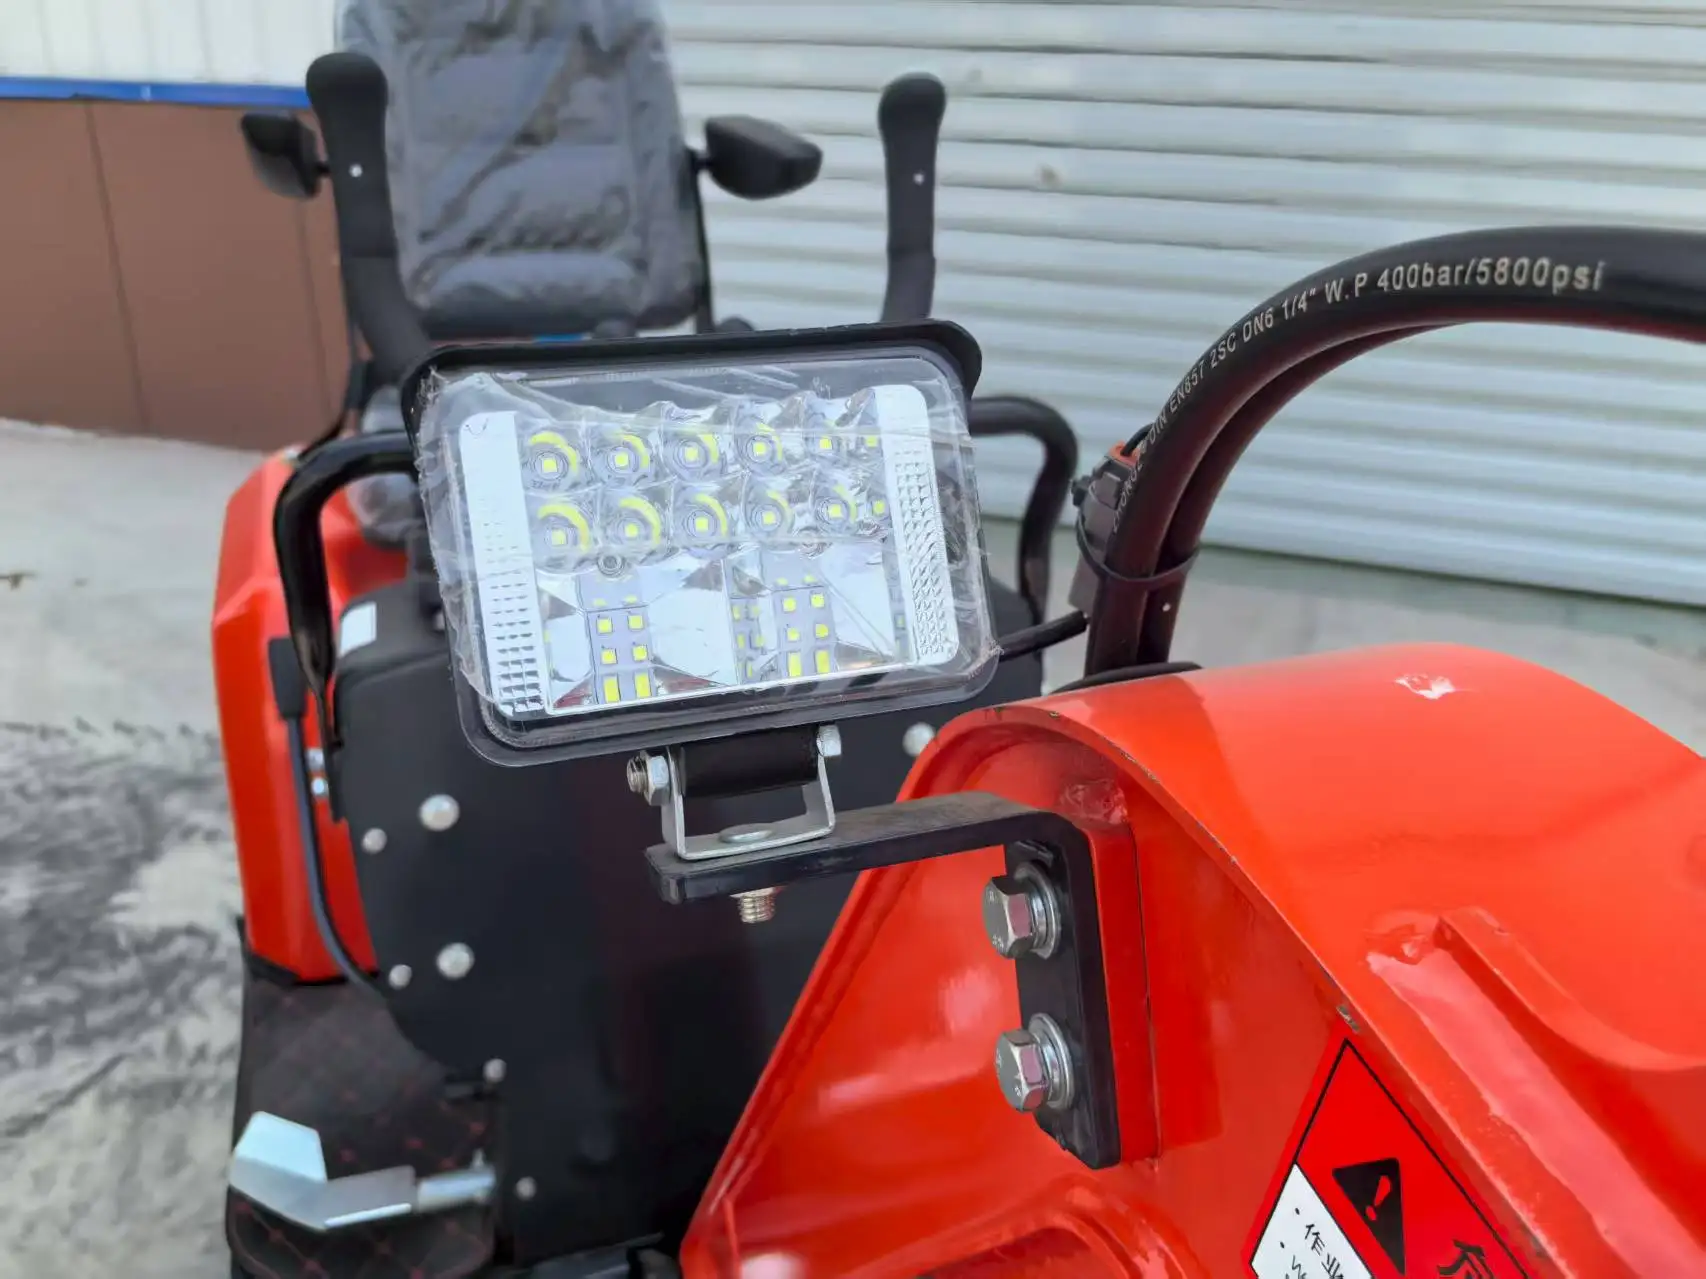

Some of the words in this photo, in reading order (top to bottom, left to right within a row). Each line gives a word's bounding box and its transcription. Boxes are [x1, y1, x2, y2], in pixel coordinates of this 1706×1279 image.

[1169, 360, 1205, 413] EN857
[1210, 332, 1237, 368] 2SC
[1242, 307, 1274, 343] DN6
[1377, 256, 1605, 295] 400bar/5800psi
